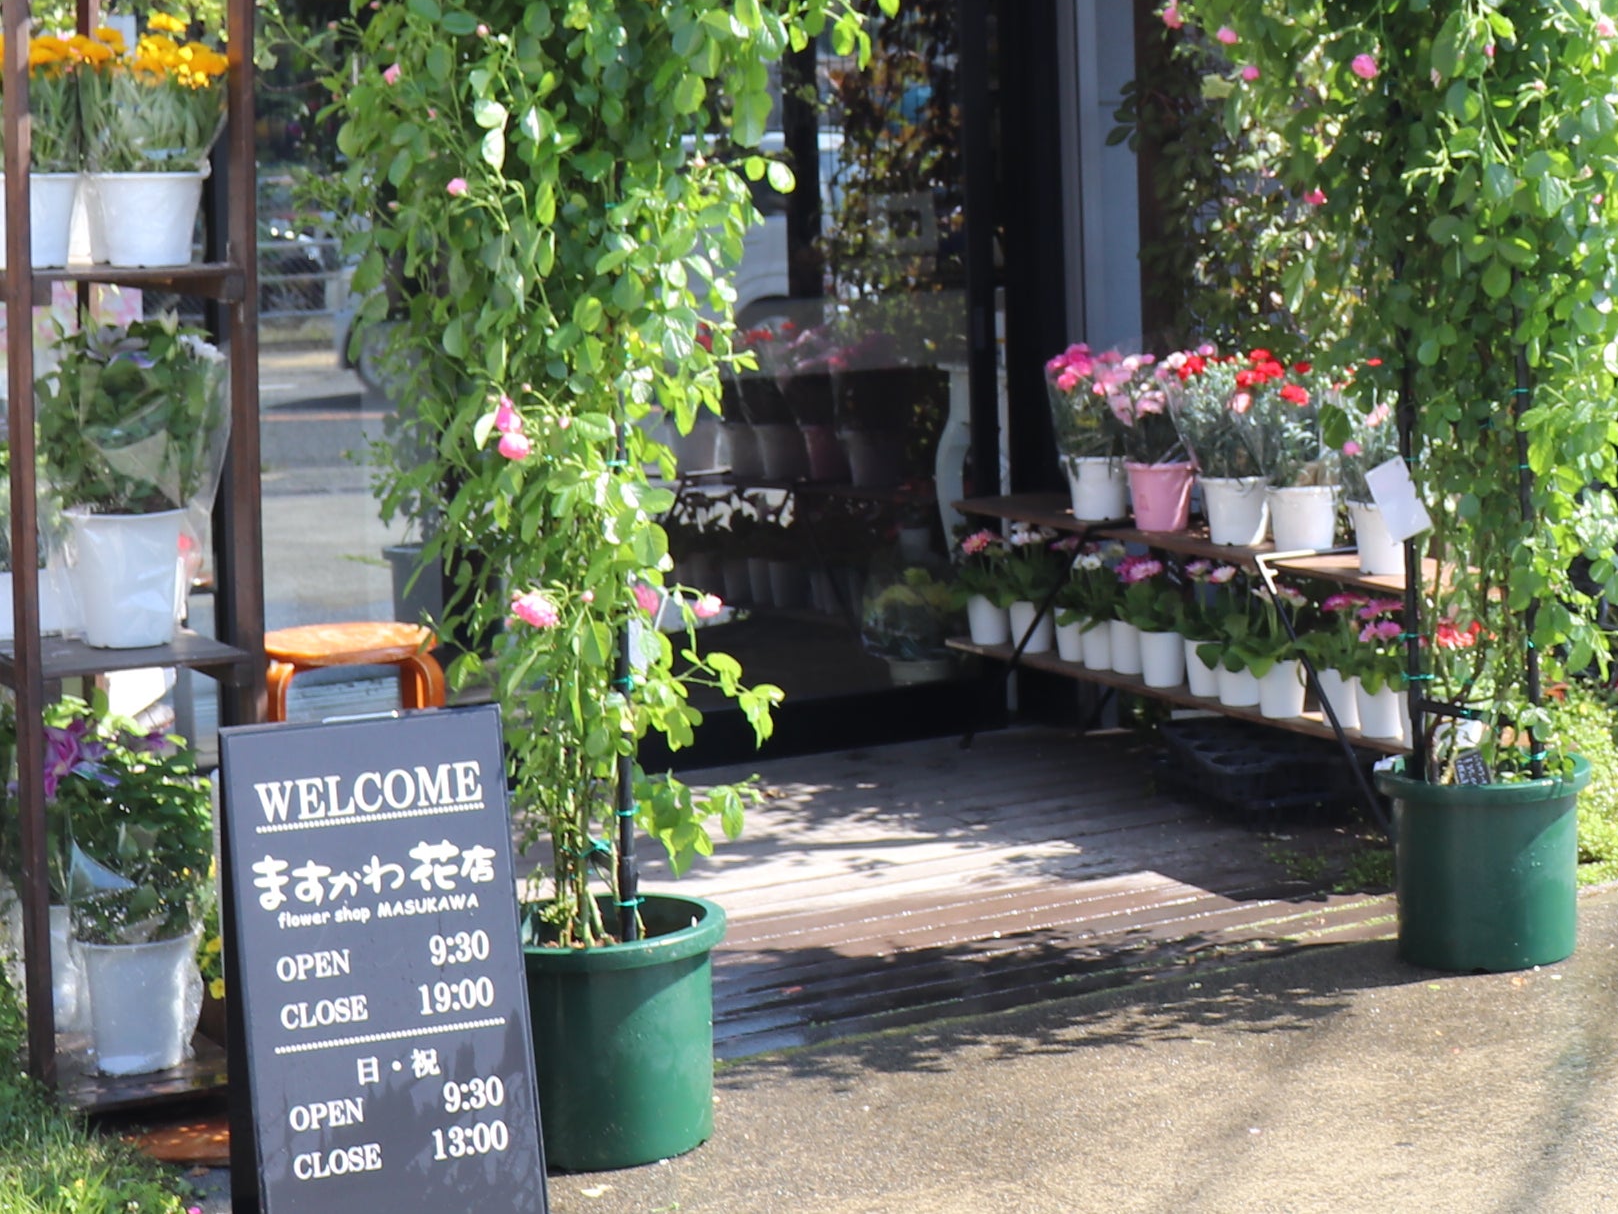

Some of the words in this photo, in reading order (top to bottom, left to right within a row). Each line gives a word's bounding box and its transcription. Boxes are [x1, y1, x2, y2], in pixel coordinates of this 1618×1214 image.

[254, 761, 483, 823] WELCOME
[252, 839, 496, 910] ますかわ花店
[278, 911, 331, 929] flower
[335, 905, 371, 924] shop
[377, 893, 479, 918] MASUKAWA
[276, 949, 350, 981] OPEN
[429, 930, 489, 966] 9:30
[281, 995, 368, 1029] CLOSE
[418, 976, 494, 1015] 19:00
[290, 1097, 363, 1131] OPEN
[443, 1076, 504, 1113] 9:30
[294, 1144, 381, 1179] CLOSE
[432, 1120, 509, 1160] 13:00
